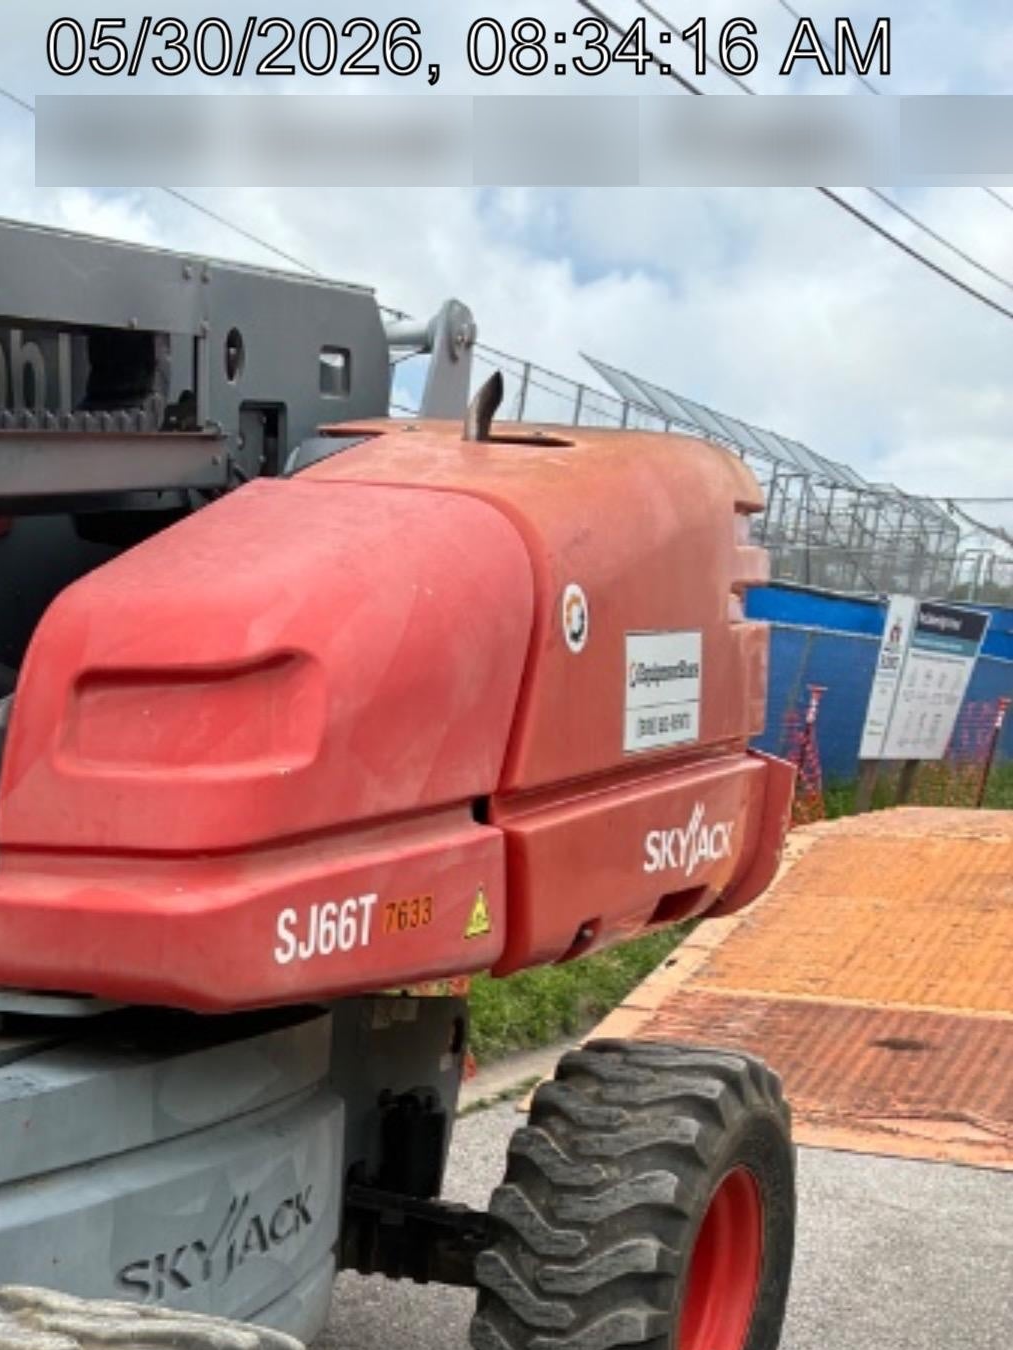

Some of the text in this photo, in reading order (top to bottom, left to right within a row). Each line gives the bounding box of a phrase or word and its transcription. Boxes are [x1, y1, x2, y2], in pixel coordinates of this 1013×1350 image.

[643, 802, 735, 876] SKYJACK
[274, 893, 433, 964] SJ66T 7633
[116, 1184, 313, 1299] SKYJACK
